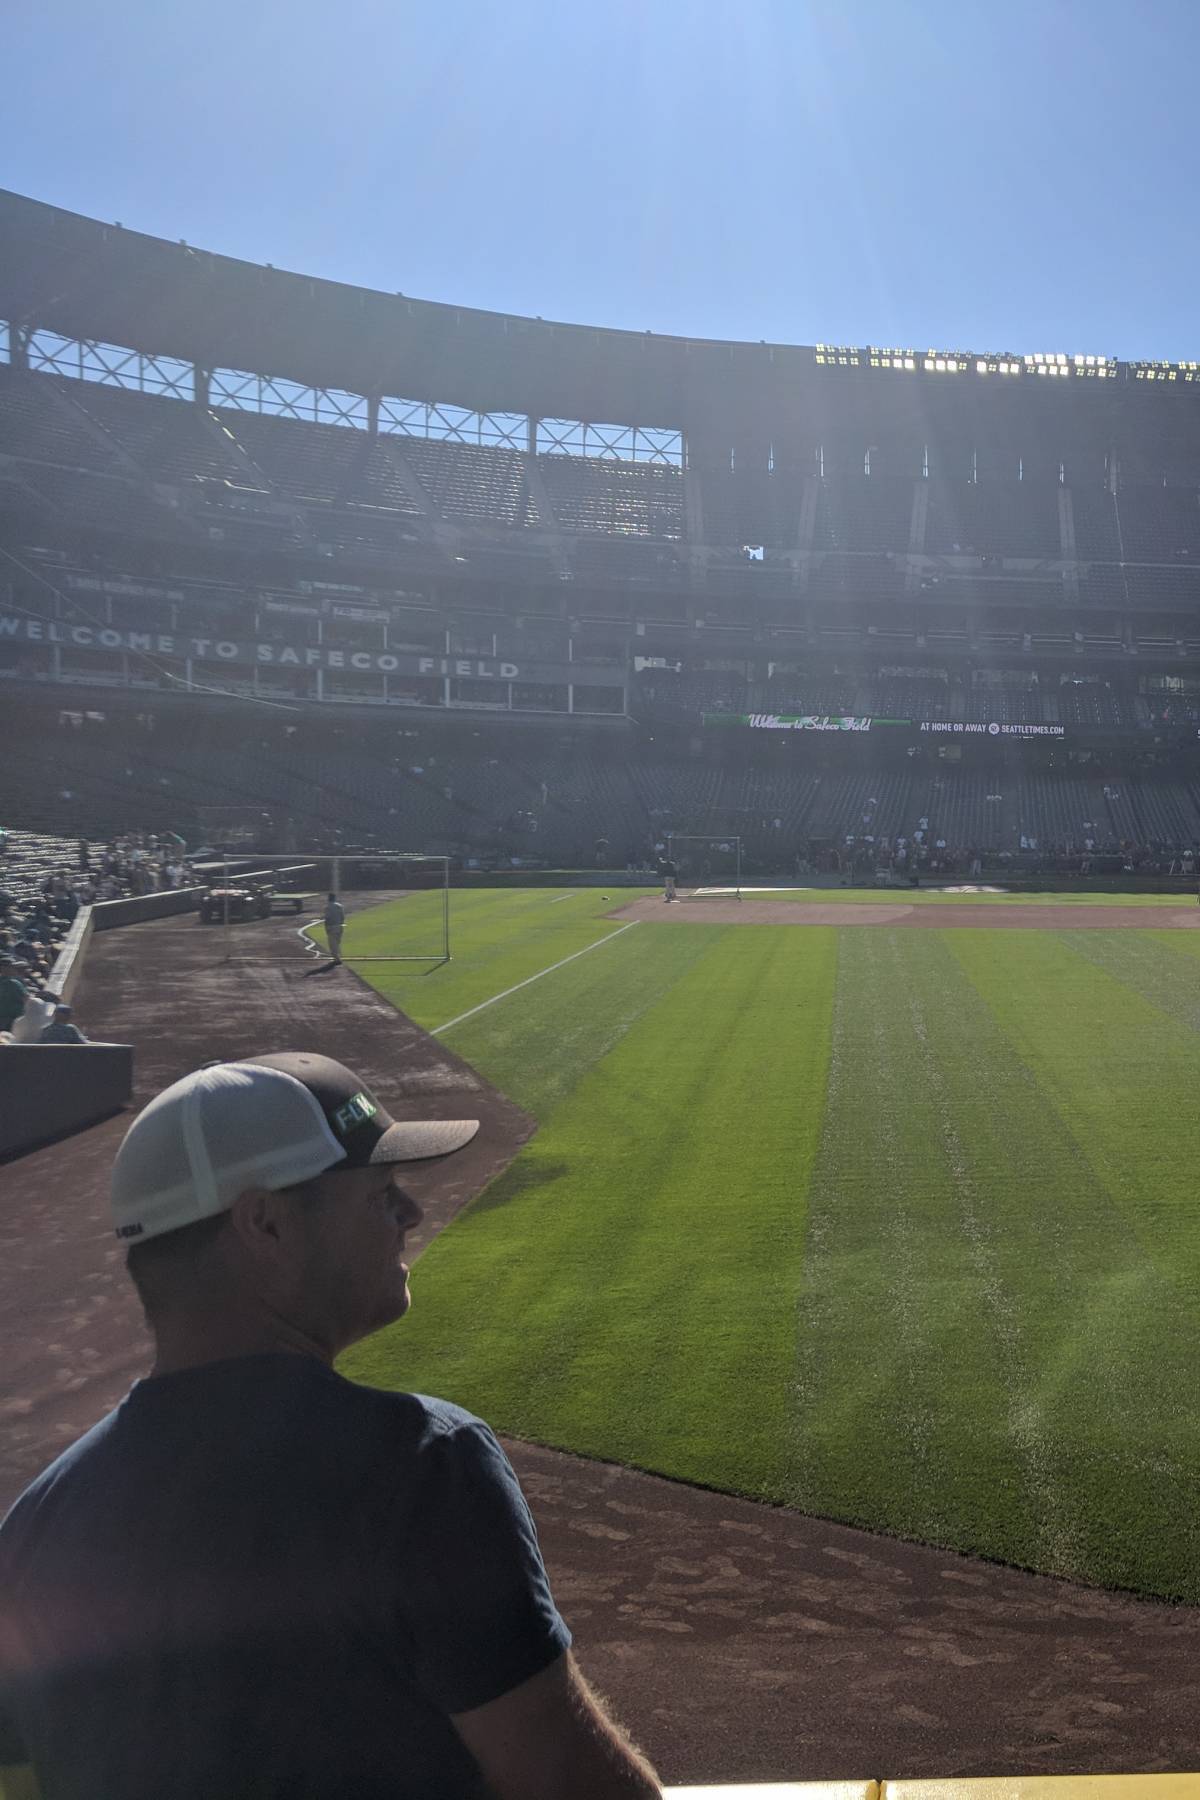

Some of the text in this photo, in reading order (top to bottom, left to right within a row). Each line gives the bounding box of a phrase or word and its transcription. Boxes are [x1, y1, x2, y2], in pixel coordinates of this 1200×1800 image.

[0, 617, 519, 678] WELCOME TO SAFECO FIELD
[921, 722, 931, 731] AT
[932, 722, 952, 732] HOME
[953, 723, 964, 732] OR
[965, 723, 986, 733] AWAY
[1001, 725, 1065, 735] SEATTLETIMES.COM
